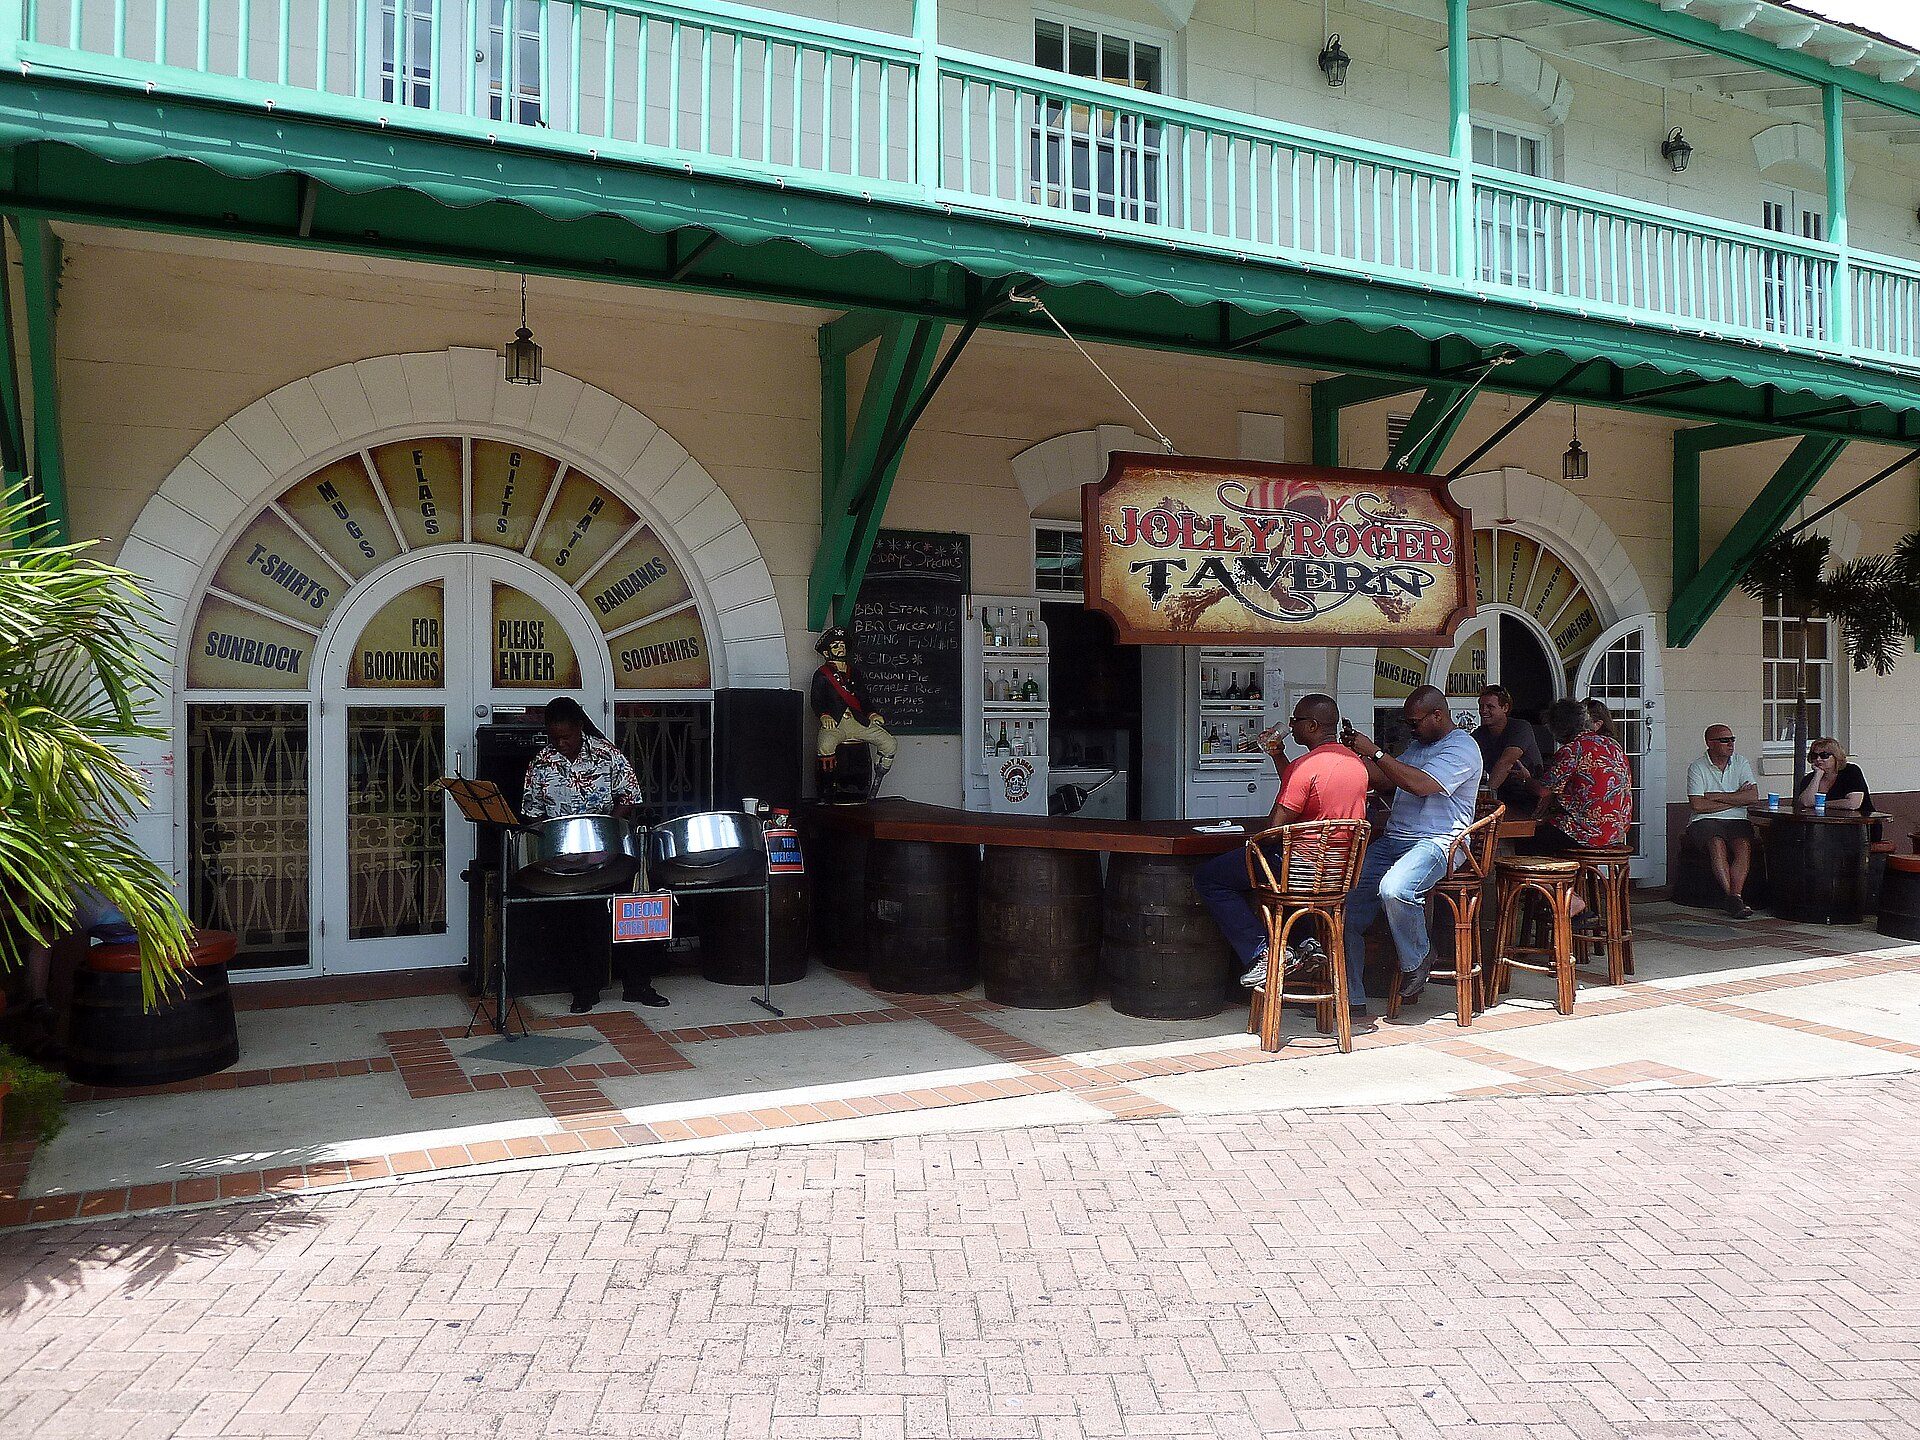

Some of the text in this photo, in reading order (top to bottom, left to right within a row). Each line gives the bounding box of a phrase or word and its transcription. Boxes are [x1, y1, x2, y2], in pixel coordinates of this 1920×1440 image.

[412, 450, 440, 535] FLAGS
[496, 452, 521, 534] GIFTS
[316, 480, 376, 559] MUGS
[555, 495, 605, 567] HATS
[1107, 480, 1453, 566] JOLLY ROGER
[246, 543, 329, 608] T-SHIRTS
[594, 557, 668, 615] BANDANAS
[1130, 557, 1435, 622] TAVERN
[1507, 541, 1520, 602] COFFEE
[854, 602, 884, 617] BBQ
[888, 601, 929, 616] STEAK
[854, 619, 885, 634] BBQ
[888, 619, 935, 633] CHICKEN
[411, 617, 440, 648] FOR
[498, 619, 546, 650] PLEASE
[1554, 608, 1594, 652] FLYING FISH
[204, 630, 303, 674] SUNBLOCK
[363, 650, 440, 681] BOOKINGS
[499, 650, 556, 681] ENTER
[620, 635, 701, 673] SOUVENIRS
[867, 651, 910, 666] SIDES
[1401, 667, 1422, 688] BEER
[617, 920, 646, 936] STEEL
[622, 900, 663, 919] BEON
